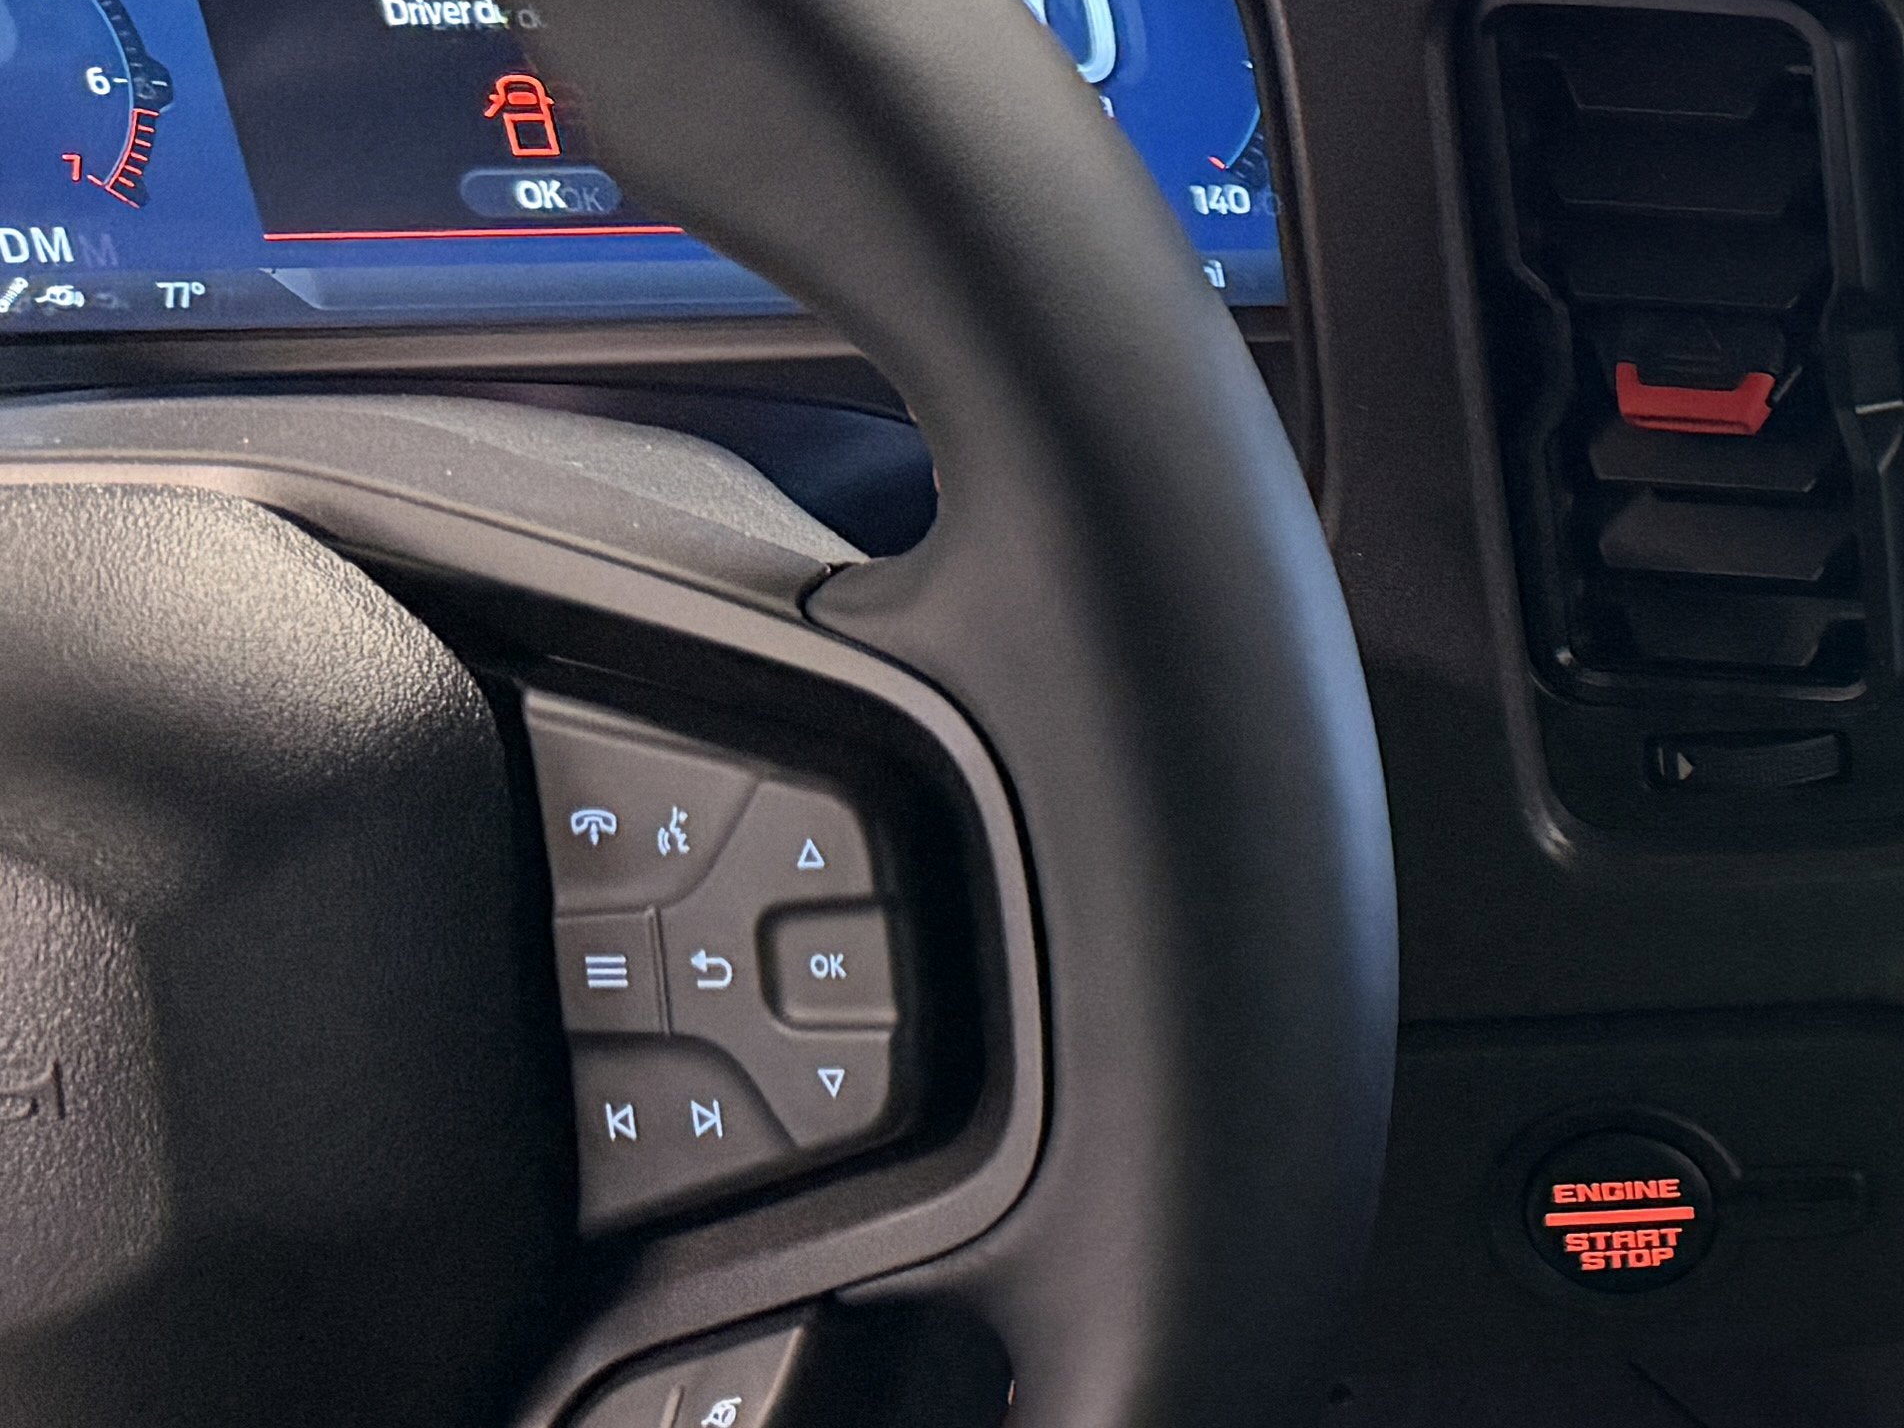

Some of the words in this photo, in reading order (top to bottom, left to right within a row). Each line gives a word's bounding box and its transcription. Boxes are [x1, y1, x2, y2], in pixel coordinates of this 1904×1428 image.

[86, 66, 111, 95] 6
[61, 152, 83, 182] 7
[516, 179, 566, 210] OK
[1189, 184, 1252, 216] 140
[810, 952, 847, 981] OK
[1551, 1178, 1682, 1204] ENGINE
[1564, 1228, 1683, 1252] START
[1580, 1247, 1675, 1271] STOP
